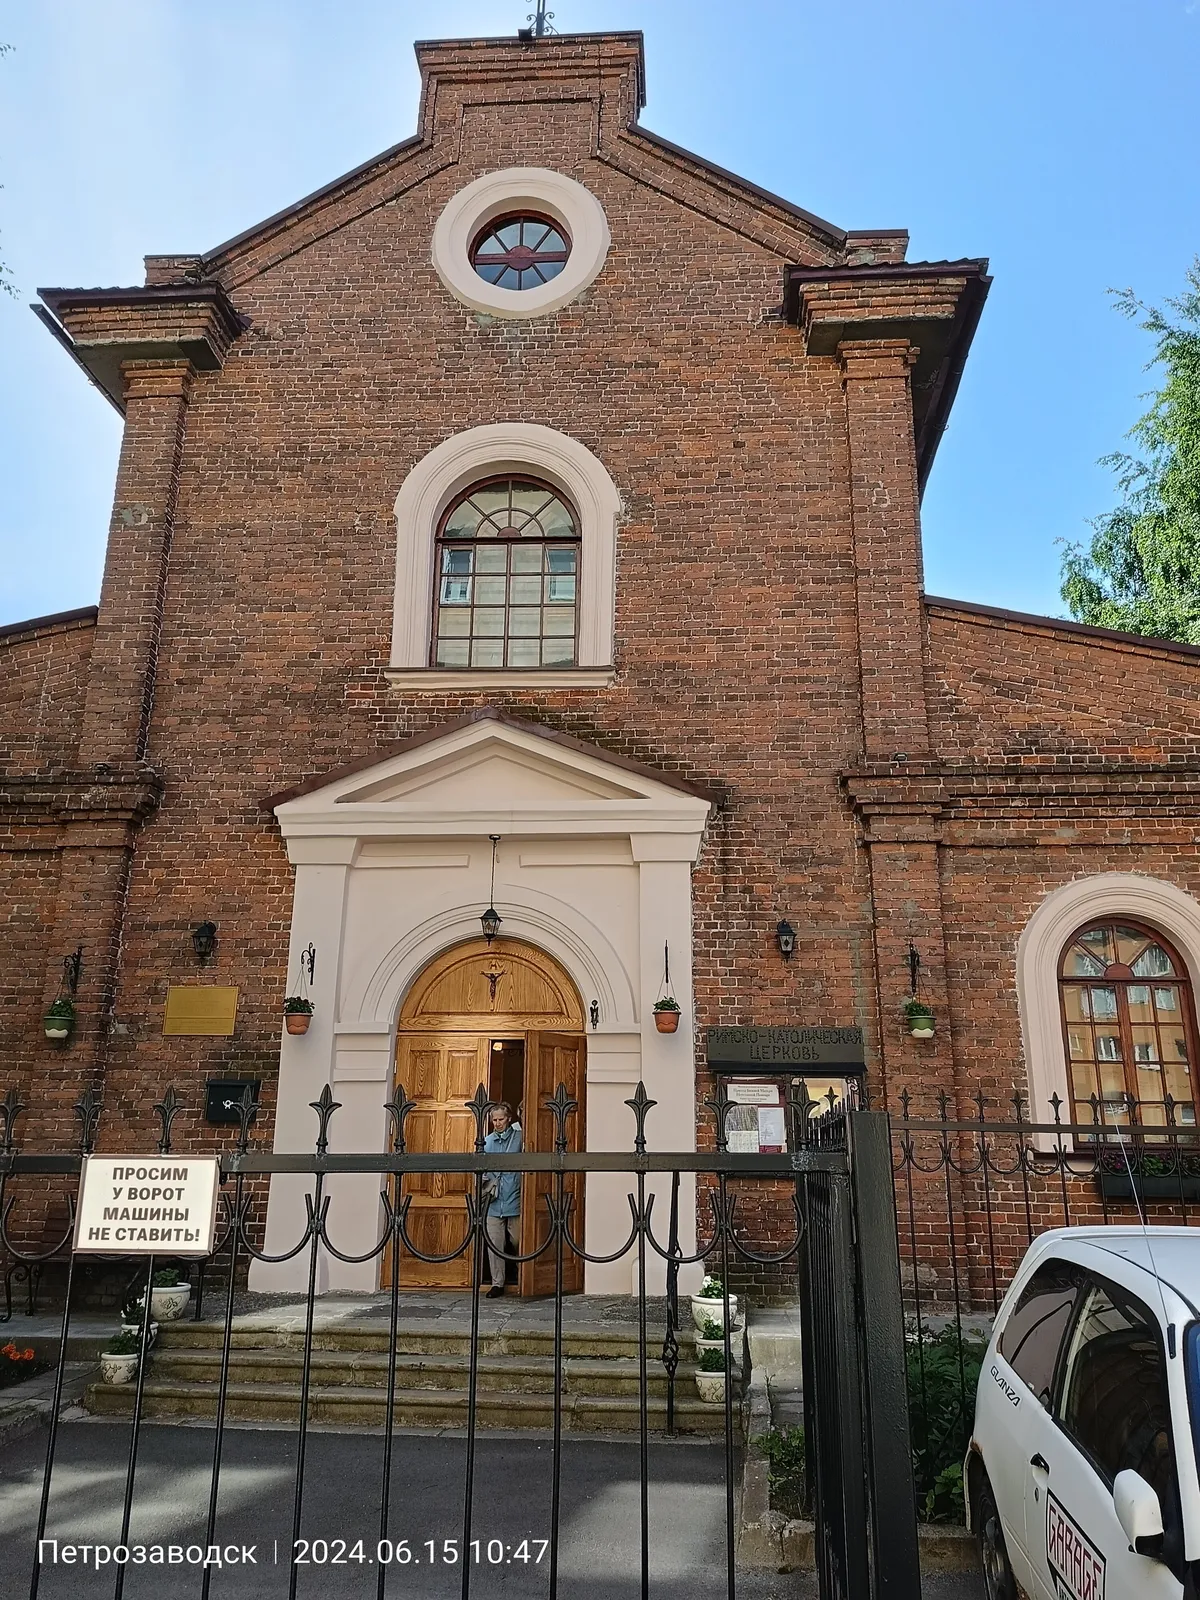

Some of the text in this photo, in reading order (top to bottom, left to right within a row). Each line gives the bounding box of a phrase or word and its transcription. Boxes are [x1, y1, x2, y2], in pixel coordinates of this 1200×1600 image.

[708, 1029, 863, 1045] РИМСКО-КАТОЛИЧЕСКАЯ
[750, 1045, 820, 1061] ЦЕРКОВЬ
[112, 1167, 189, 1181] ПРОСИМ
[112, 1187, 185, 1201] У ВОРОТ
[103, 1207, 190, 1221] МАШИНЫ
[88, 1227, 200, 1242] НЕ СТАВИТЬ!
[990, 1365, 1021, 1407] GLANZA
[1048, 1503, 1102, 1600] GARAGE
